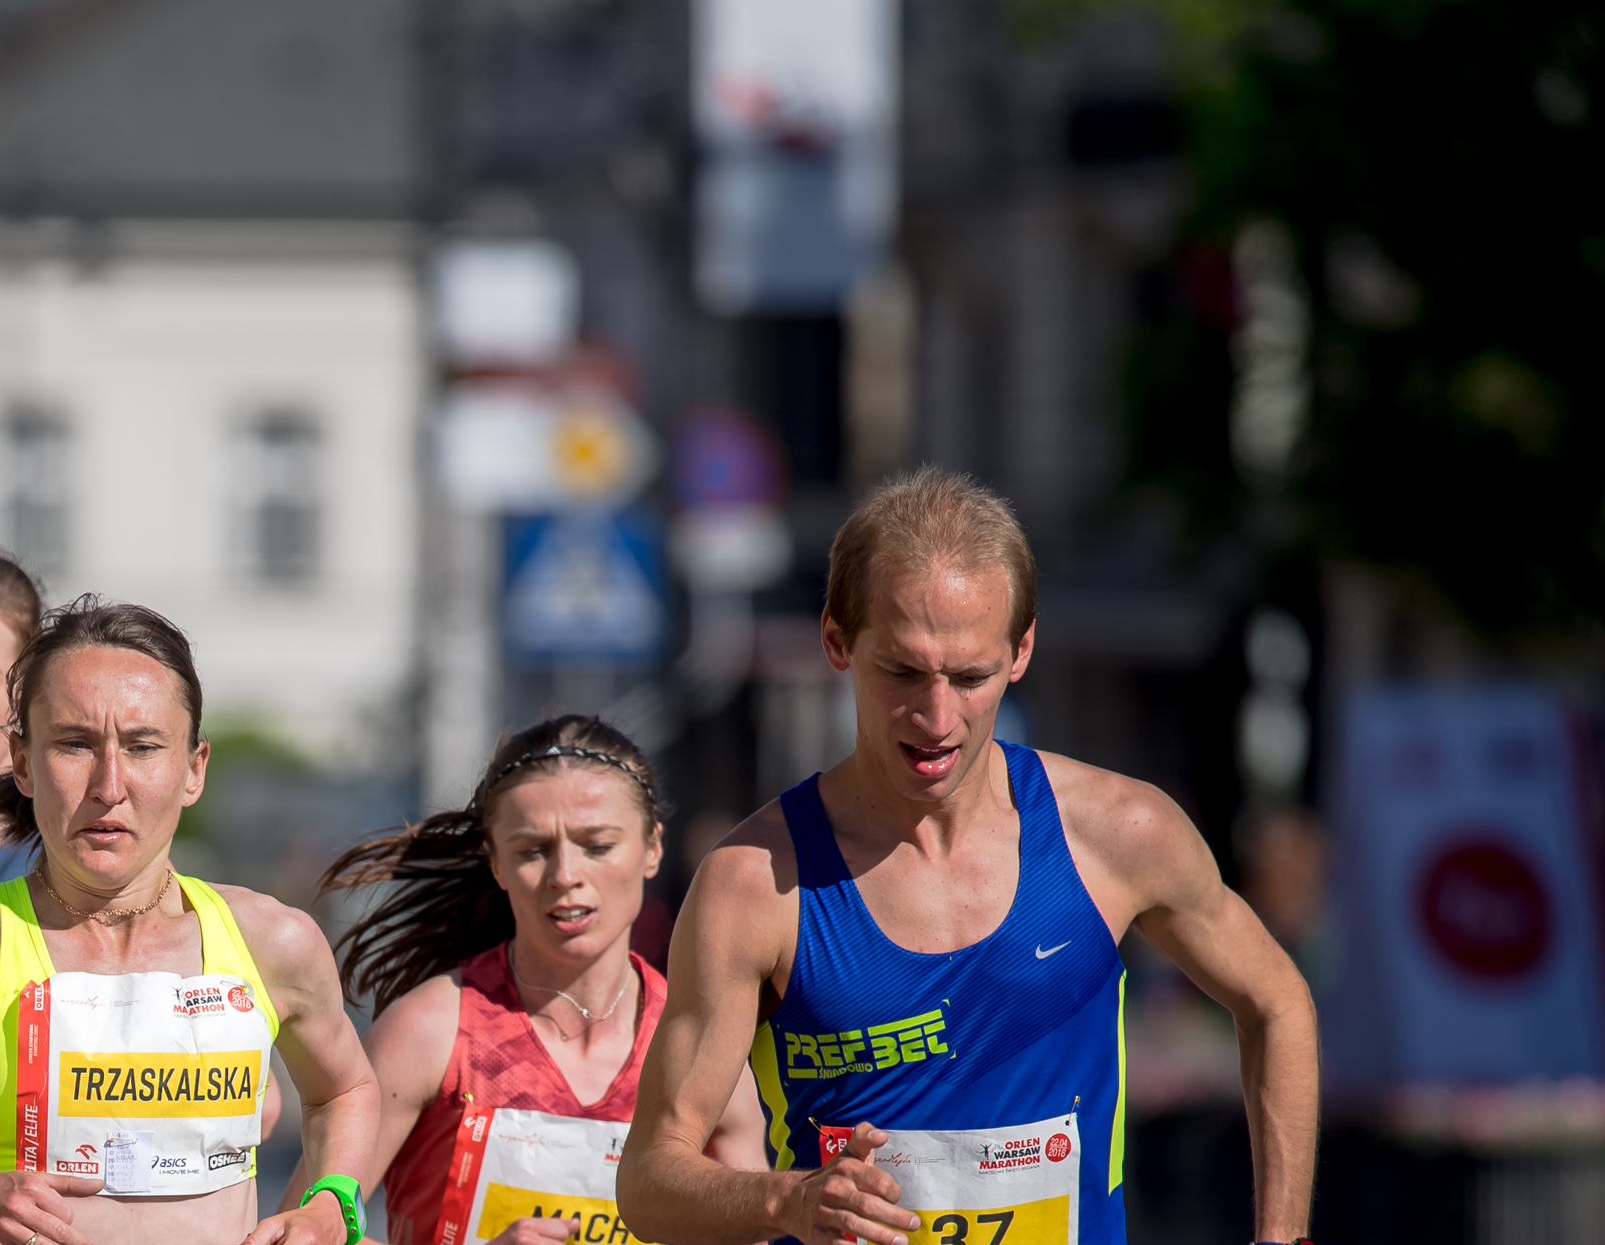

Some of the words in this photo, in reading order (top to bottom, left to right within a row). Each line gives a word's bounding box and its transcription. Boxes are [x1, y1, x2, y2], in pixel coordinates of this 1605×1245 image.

[185, 987, 221, 999] ORLEN
[184, 995, 222, 1008] ARSAW
[232, 998, 252, 1009] 2018
[173, 1003, 225, 1016] MAATHON
[71, 1066, 251, 1102] TRZASKALSKA
[24, 1104, 38, 1137] ELITE
[1005, 1137, 1041, 1150] ORLEN
[994, 1146, 1041, 1160] WARSAW
[1047, 1148, 1067, 1158] 2018
[210, 1153, 245, 1168] OSHEE
[979, 1155, 1041, 1170] MARATHON
[59, 1163, 96, 1173] ORLEN
